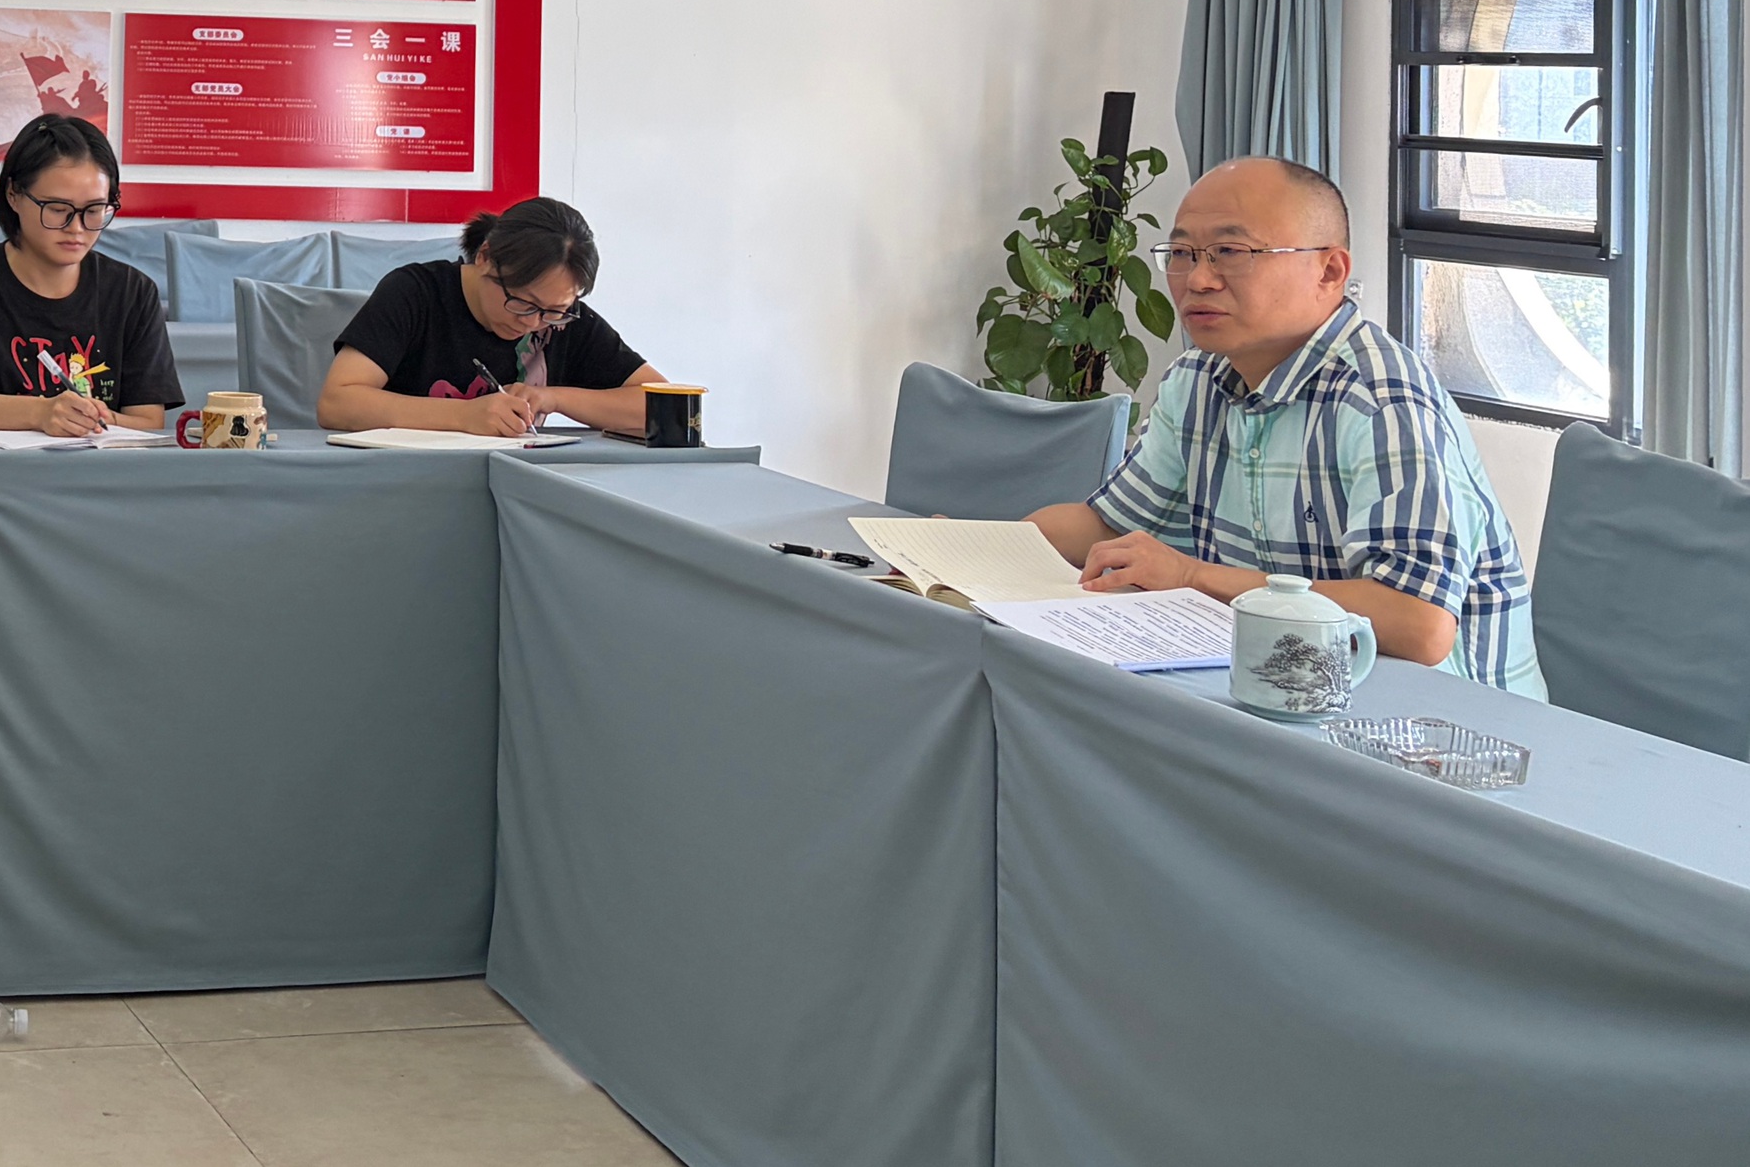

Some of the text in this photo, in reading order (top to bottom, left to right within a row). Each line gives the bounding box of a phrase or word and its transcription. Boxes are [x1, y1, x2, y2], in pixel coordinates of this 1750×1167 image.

[333, 28, 462, 53] 三会一课
[362, 52, 433, 64] SAN HUI YI KE
